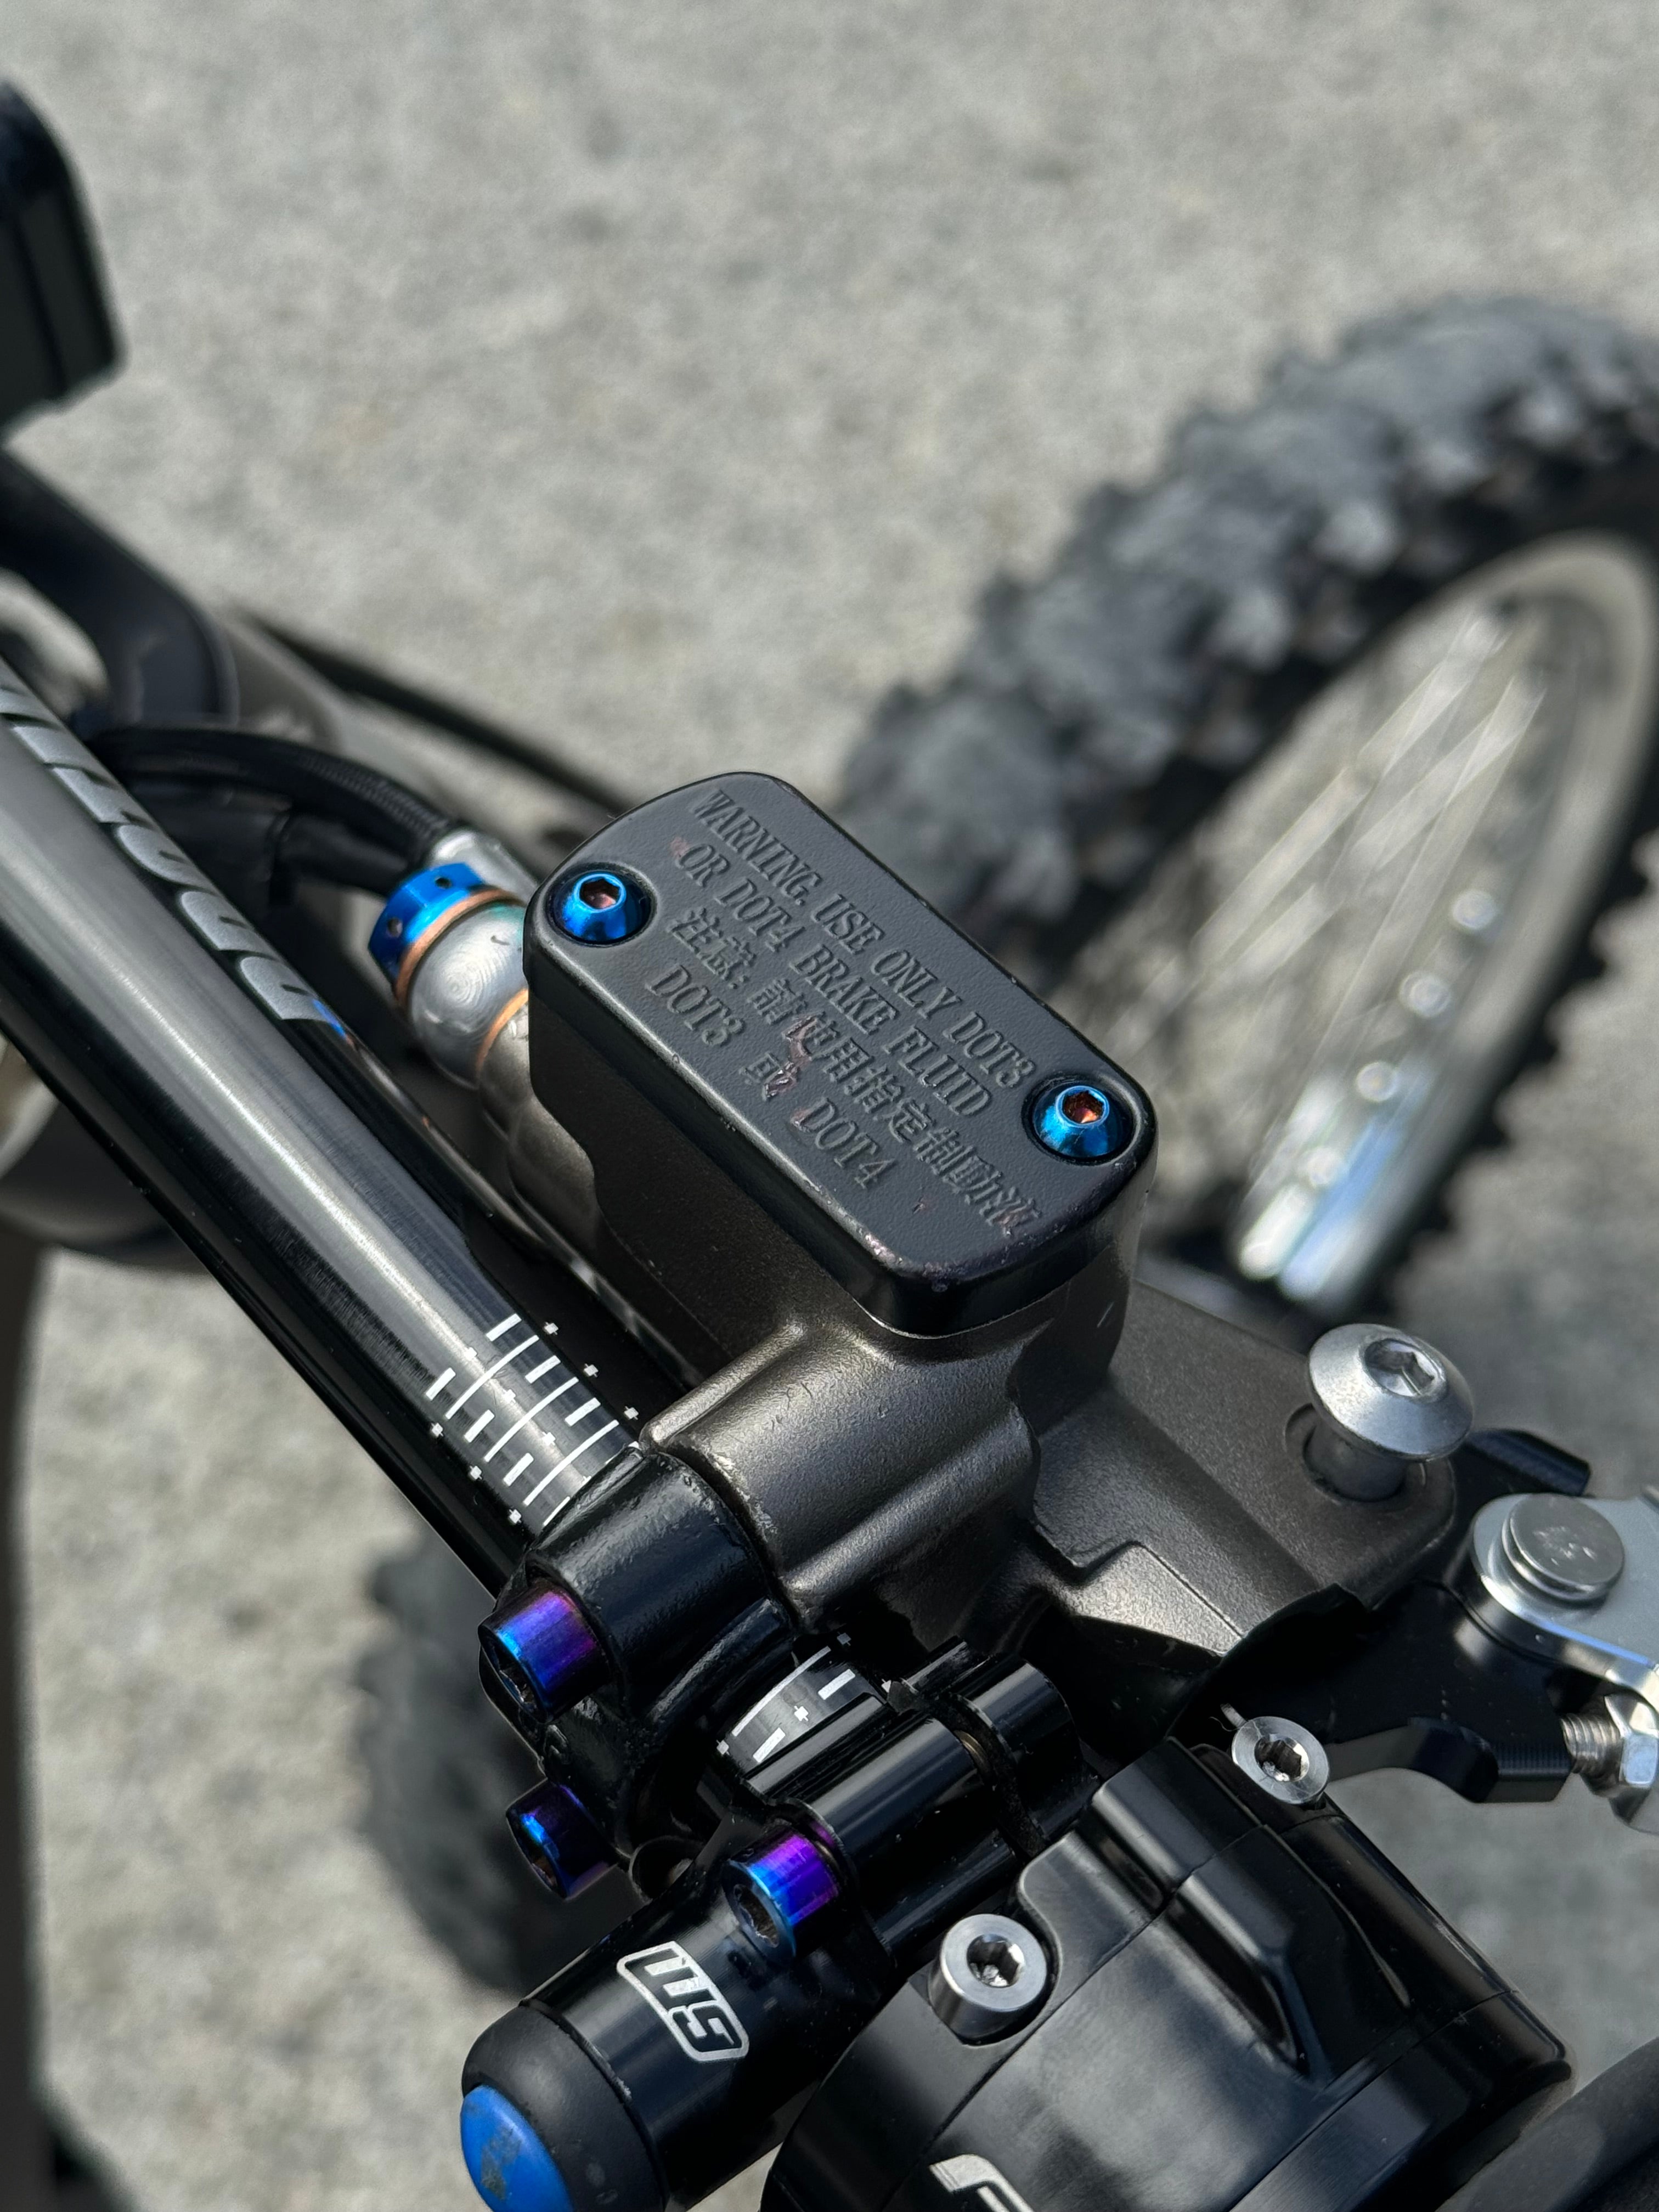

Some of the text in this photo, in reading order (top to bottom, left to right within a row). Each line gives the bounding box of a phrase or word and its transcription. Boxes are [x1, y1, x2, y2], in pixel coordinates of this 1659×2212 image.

[649, 965, 745, 1046] DOT3
[789, 1097, 896, 1189] DOT4
[675, 843, 992, 1117] OR DOT4 BRAKE FLUID
[810, 894, 885, 956] USE
[870, 948, 963, 1019] ONLY
[942, 1012, 1039, 1088] DOT3
